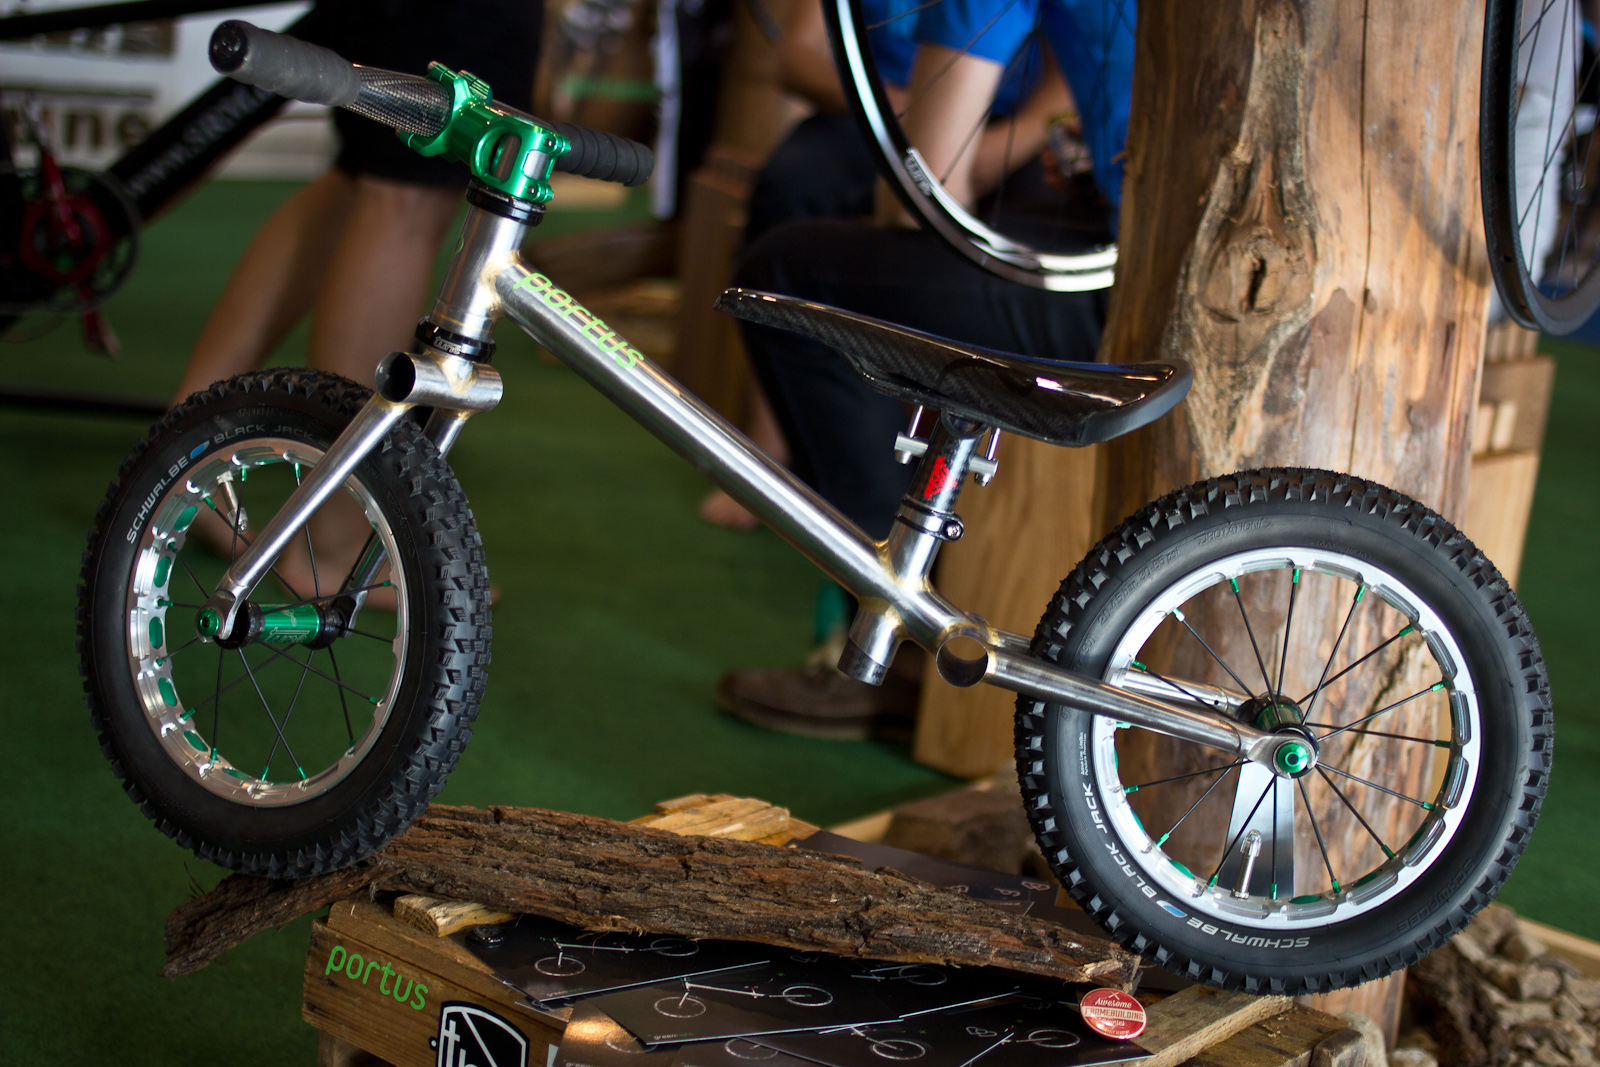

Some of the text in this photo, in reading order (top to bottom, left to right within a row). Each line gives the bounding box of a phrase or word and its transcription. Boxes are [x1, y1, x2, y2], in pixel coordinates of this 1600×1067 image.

[512, 272, 645, 368] portus
[126, 424, 314, 544] SCHWALBE BLACK JACK
[1082, 782, 1311, 949] SCHWALBE BLACK JACK
[324, 945, 430, 1011] portus
[1084, 1007, 1144, 1021] FRAMEBUILDING
[1095, 998, 1132, 1009] Awesome
